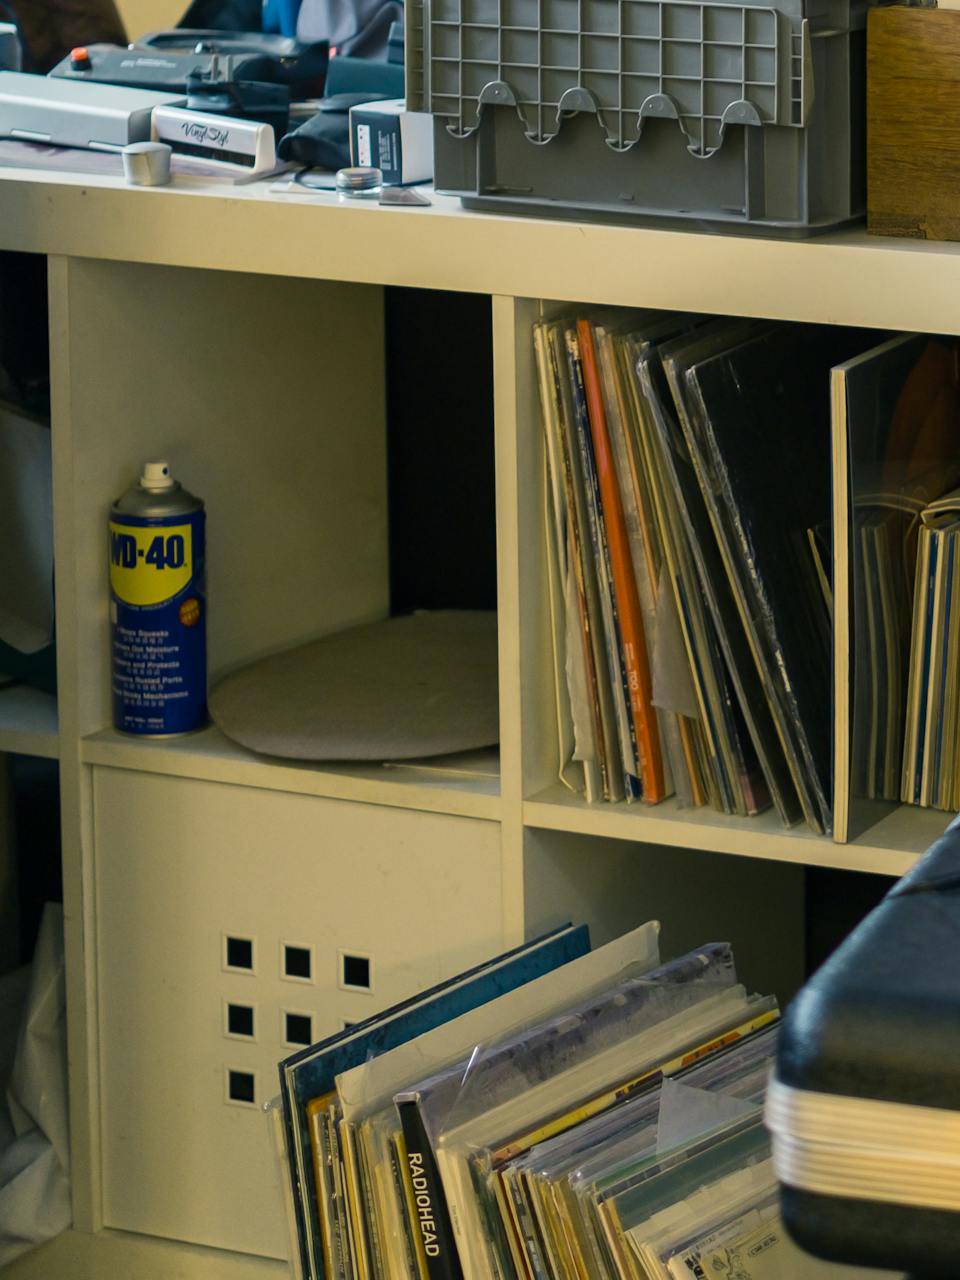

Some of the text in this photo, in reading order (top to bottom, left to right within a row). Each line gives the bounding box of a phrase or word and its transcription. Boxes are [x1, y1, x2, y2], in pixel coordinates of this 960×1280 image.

[181, 123, 208, 143] Vinyl
[111, 532, 184, 569] WD-40
[408, 1153, 440, 1257] RADIOHEAD
